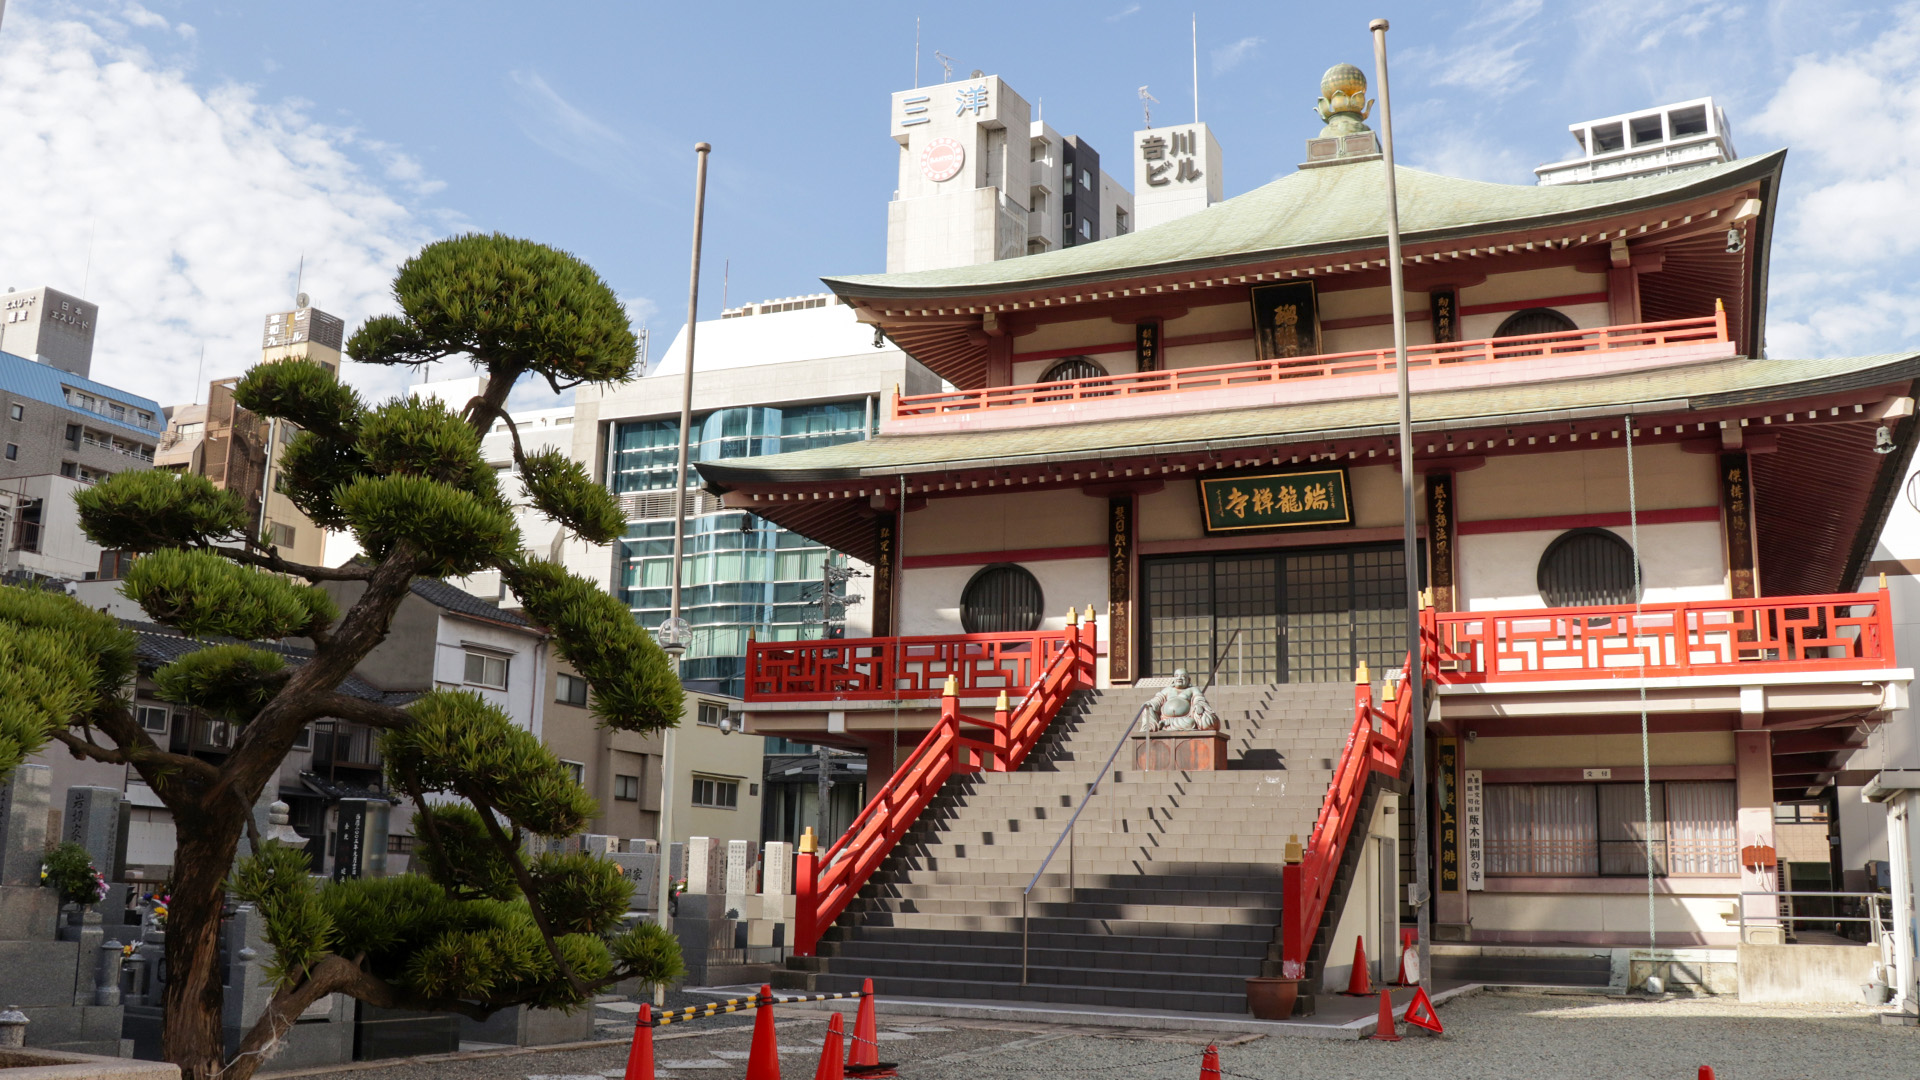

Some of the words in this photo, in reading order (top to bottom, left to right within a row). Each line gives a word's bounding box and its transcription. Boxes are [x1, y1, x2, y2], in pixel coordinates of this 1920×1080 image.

[901, 85, 987, 125] 三洋
[1146, 157, 1201, 187] ビル
[51, 310, 89, 329] エスリード
[61, 301, 82, 315] 日本
[1468, 814, 1481, 883] 版木開刻の寺
